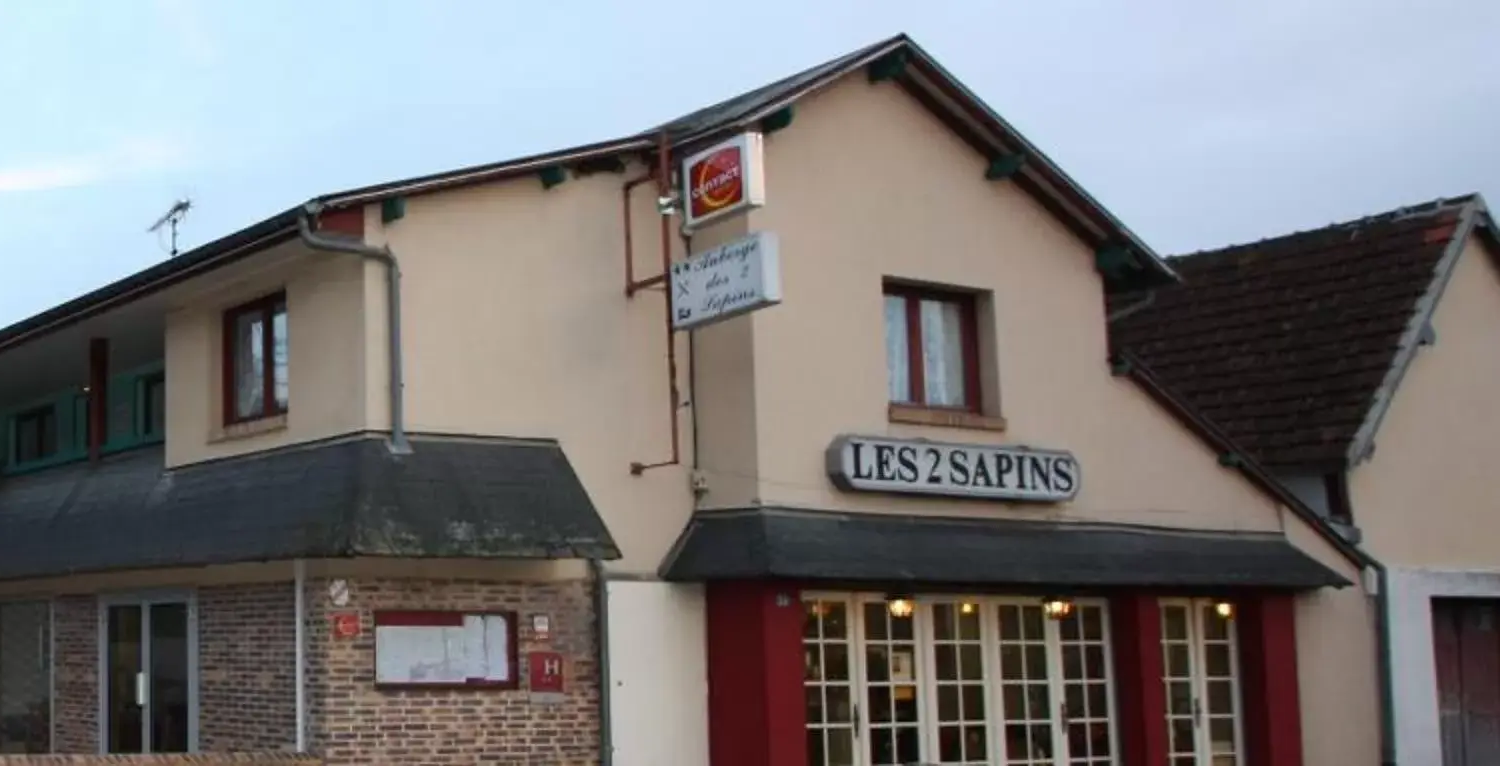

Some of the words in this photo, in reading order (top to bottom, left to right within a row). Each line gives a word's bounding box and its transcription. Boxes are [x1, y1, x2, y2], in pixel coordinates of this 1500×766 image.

[706, 273, 729, 291] des
[852, 443, 918, 483] LES
[926, 449, 942, 485] 2
[950, 450, 1073, 492] SAPINS
[544, 659, 559, 675] H
